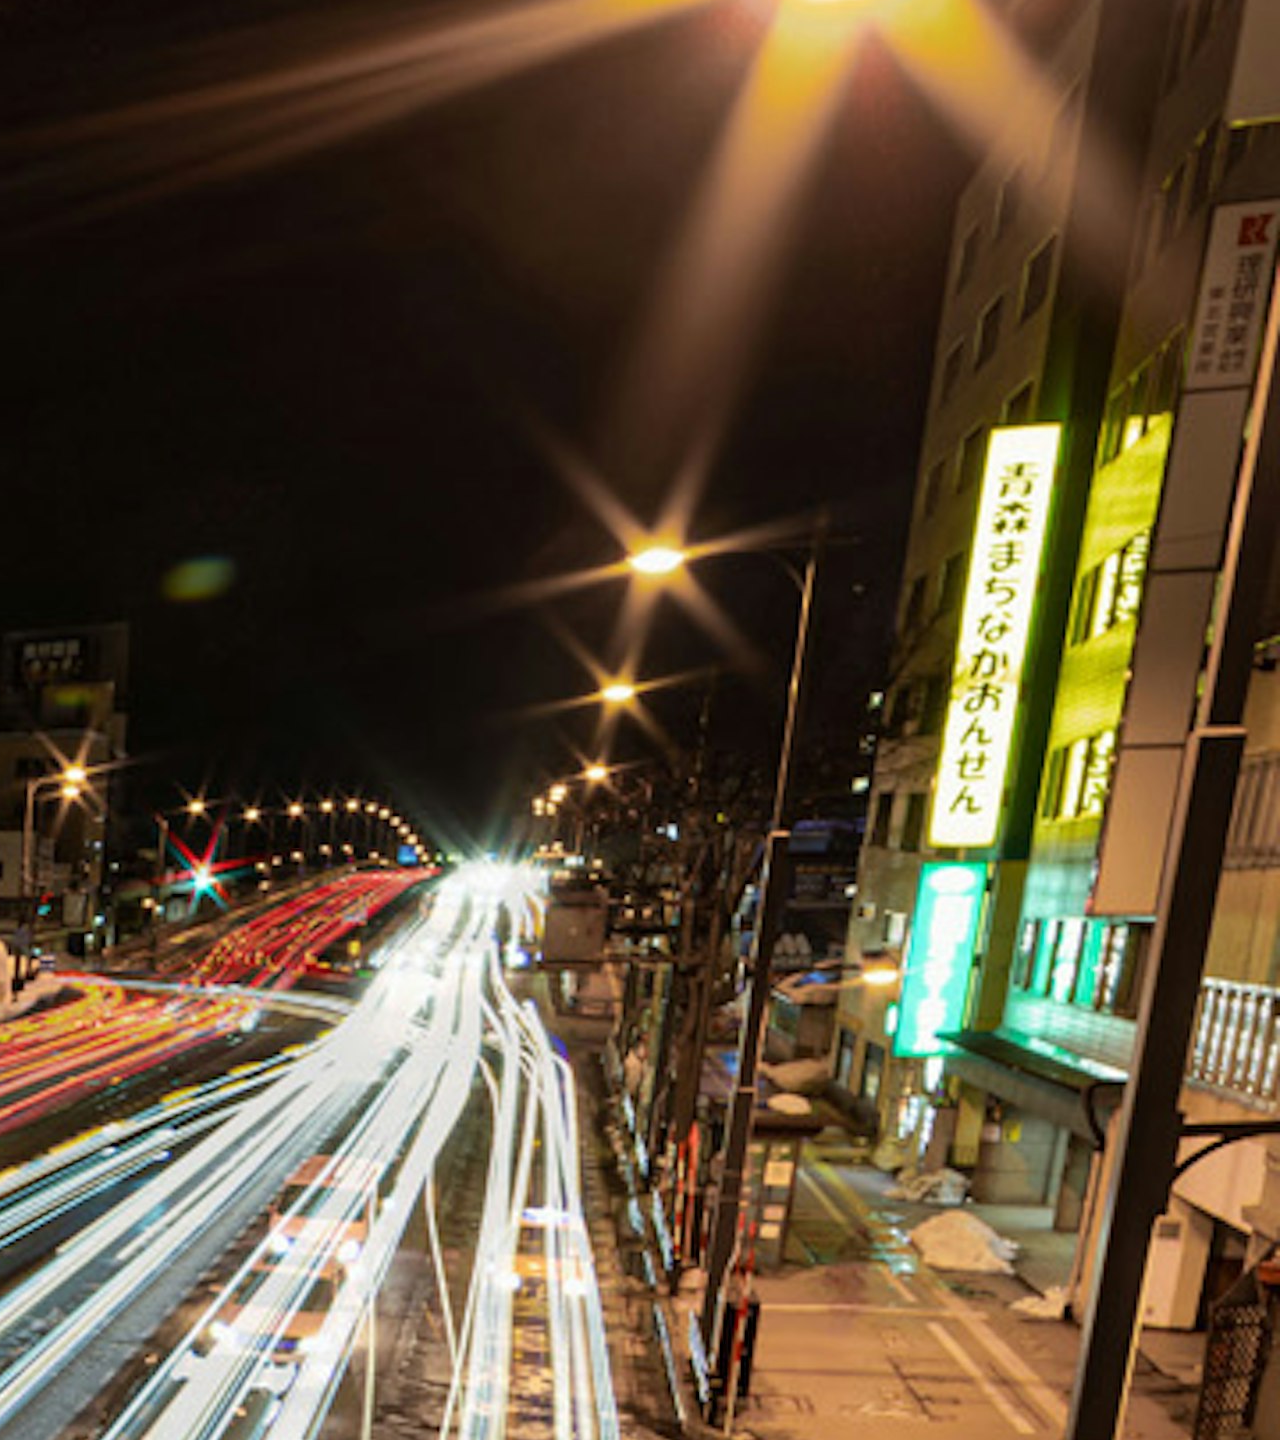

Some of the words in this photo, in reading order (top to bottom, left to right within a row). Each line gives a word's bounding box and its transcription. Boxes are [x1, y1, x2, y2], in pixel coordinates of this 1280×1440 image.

[949, 463, 1039, 814] 青森まちなかおんせん
